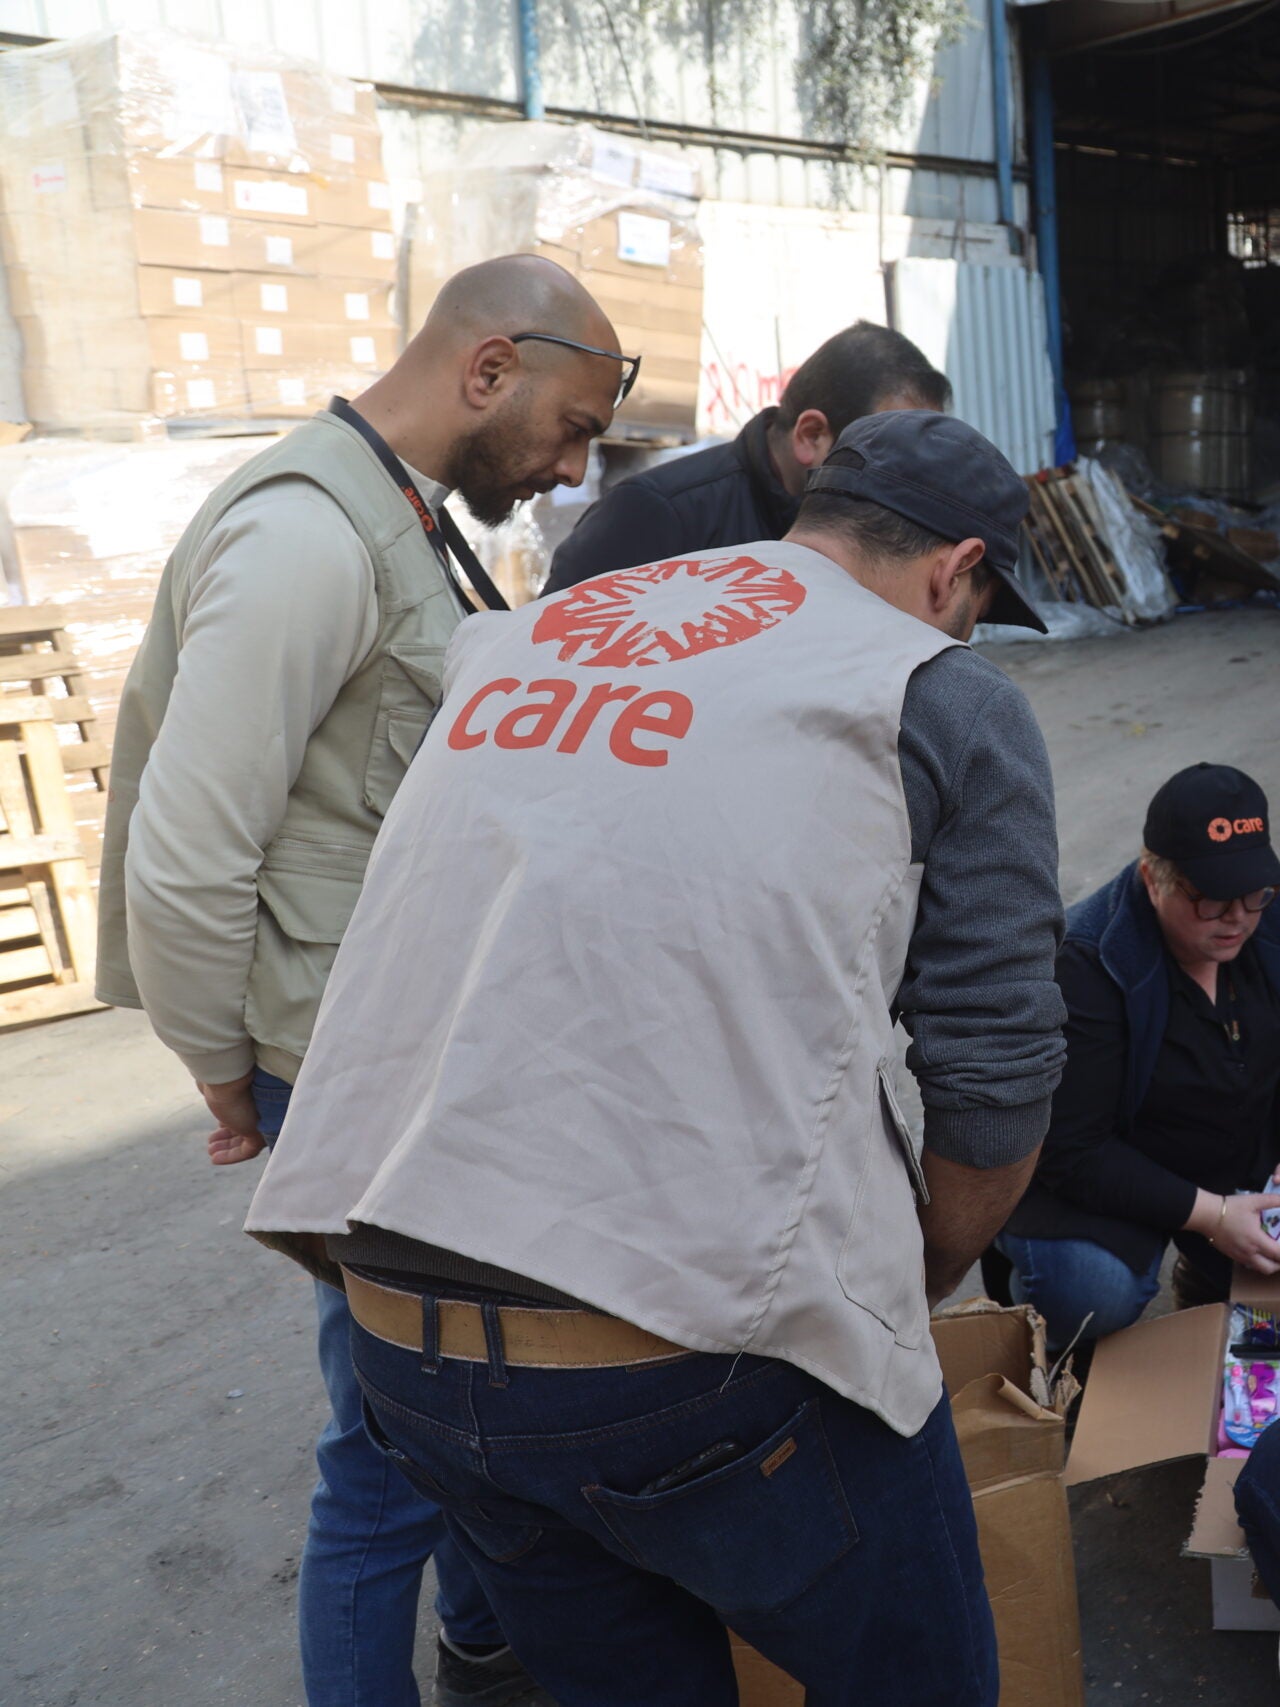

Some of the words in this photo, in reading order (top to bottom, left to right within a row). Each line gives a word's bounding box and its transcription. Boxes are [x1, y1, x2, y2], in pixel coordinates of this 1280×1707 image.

[404, 487, 424, 515] care
[448, 677, 694, 767] care
[1233, 817, 1264, 834] care
